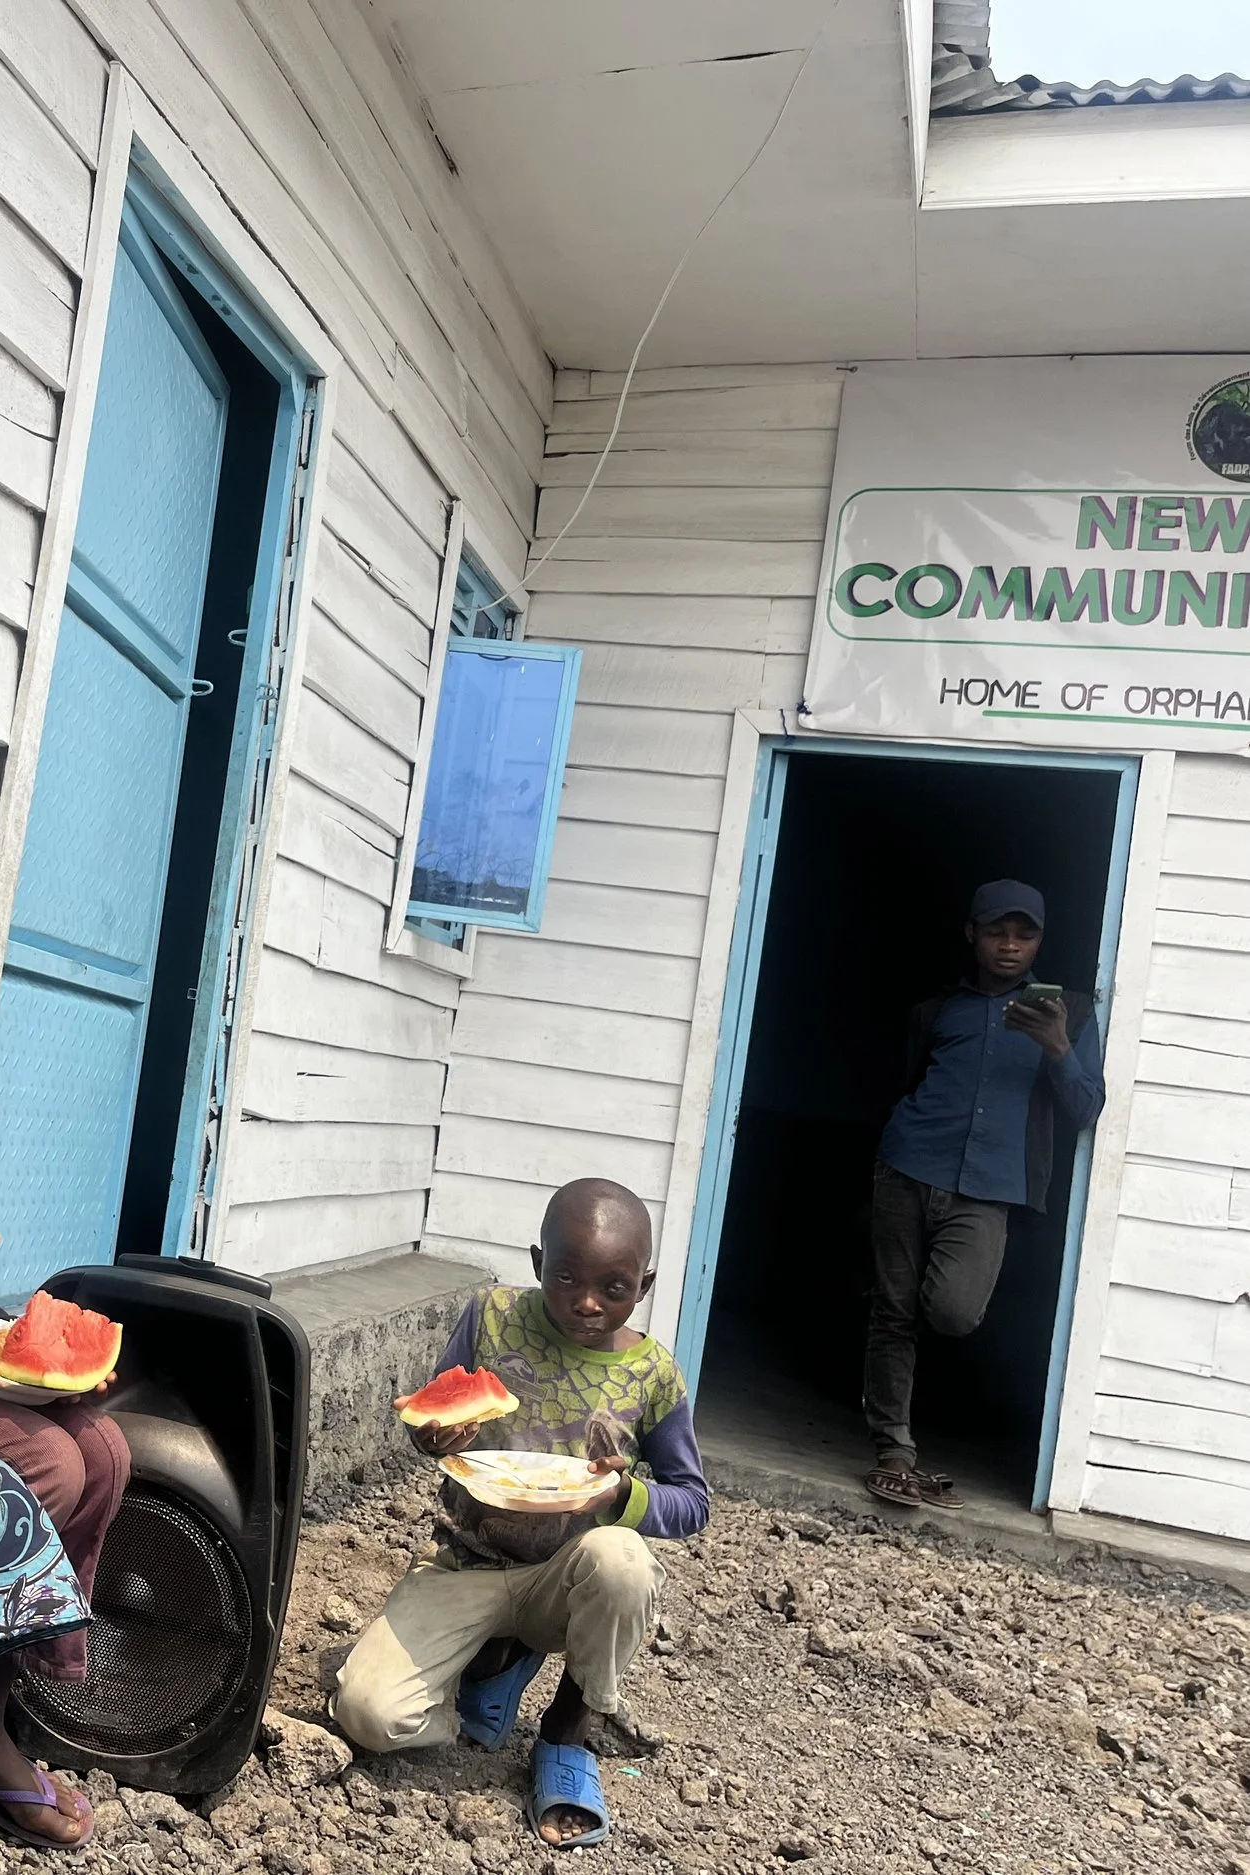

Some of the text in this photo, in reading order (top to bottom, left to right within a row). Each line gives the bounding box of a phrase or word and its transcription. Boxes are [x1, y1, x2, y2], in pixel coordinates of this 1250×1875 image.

[1221, 463, 1250, 475] FADP
[1075, 495, 1250, 554] NEW
[835, 562, 1250, 630] COMMUNI
[939, 677, 1250, 721] HOME OF ORPHA
